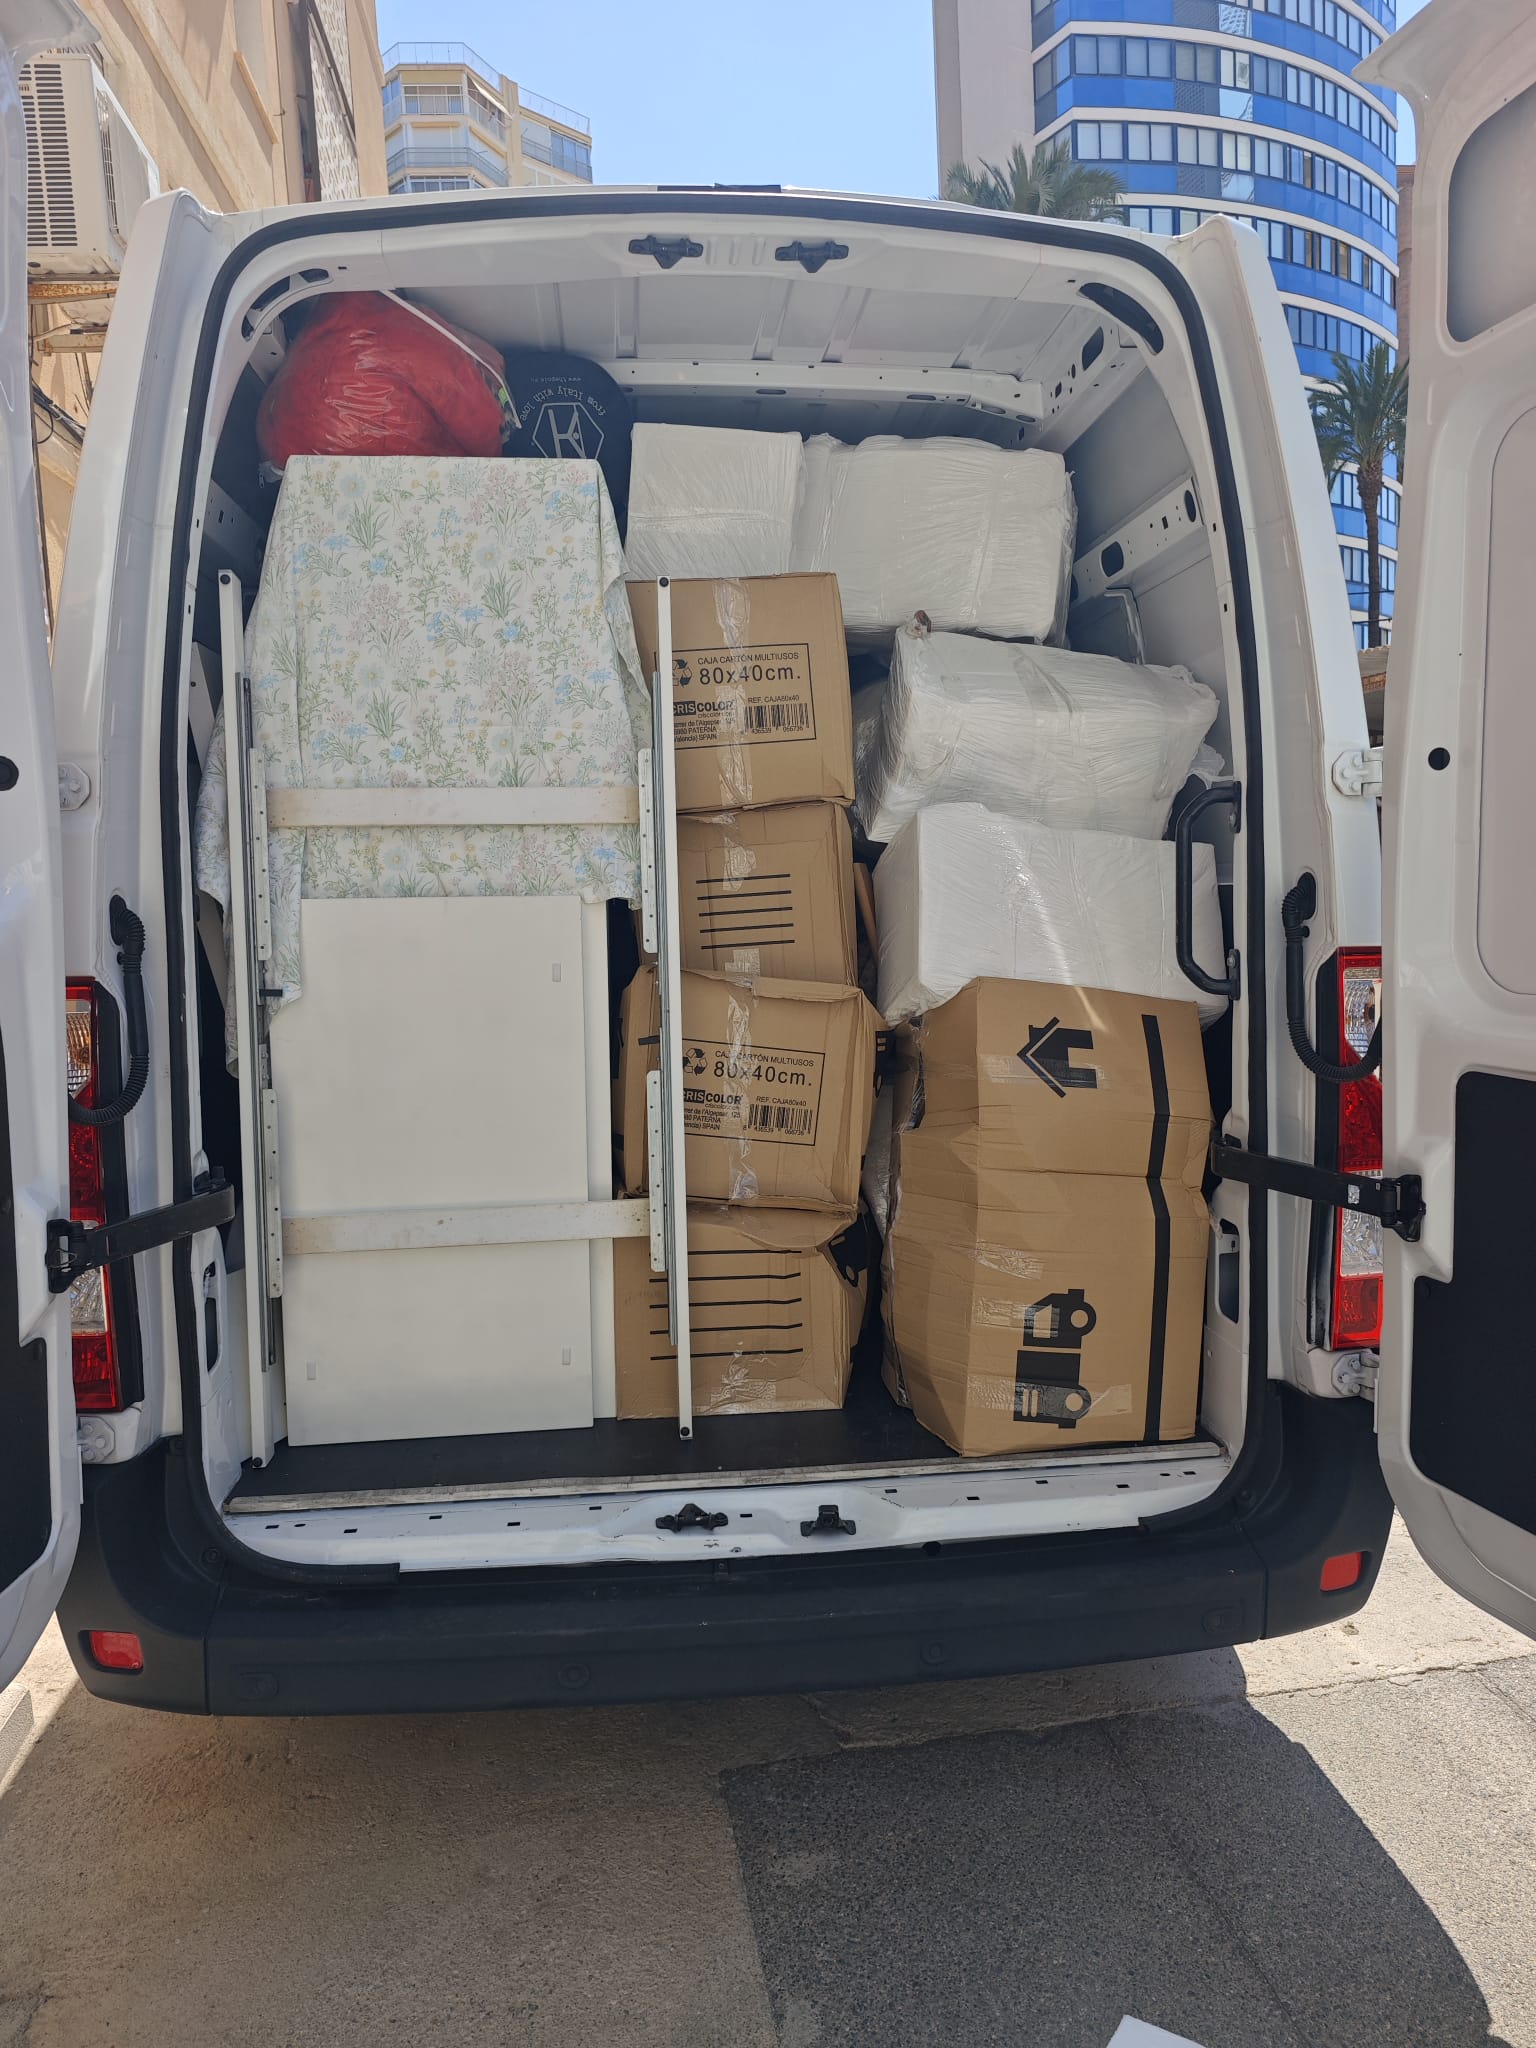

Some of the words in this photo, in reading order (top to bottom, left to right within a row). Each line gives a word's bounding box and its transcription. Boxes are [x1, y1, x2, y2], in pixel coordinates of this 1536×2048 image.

[533, 388, 554, 402] with
[558, 386, 583, 401] Italy
[519, 401, 536, 421] love
[587, 396, 607, 416] from
[697, 657, 719, 666] CAJA
[719, 653, 753, 664] CARTÓN
[754, 652, 800, 662] MULTIUSOS
[688, 726, 717, 734] PATERNA
[699, 733, 718, 741] SPAIN
[770, 1056, 815, 1067] MULTIUSOS
[683, 1089, 742, 1104] RISCOLOR
[693, 1114, 721, 1123] PATERNA
[702, 1123, 720, 1131] SPAIN
